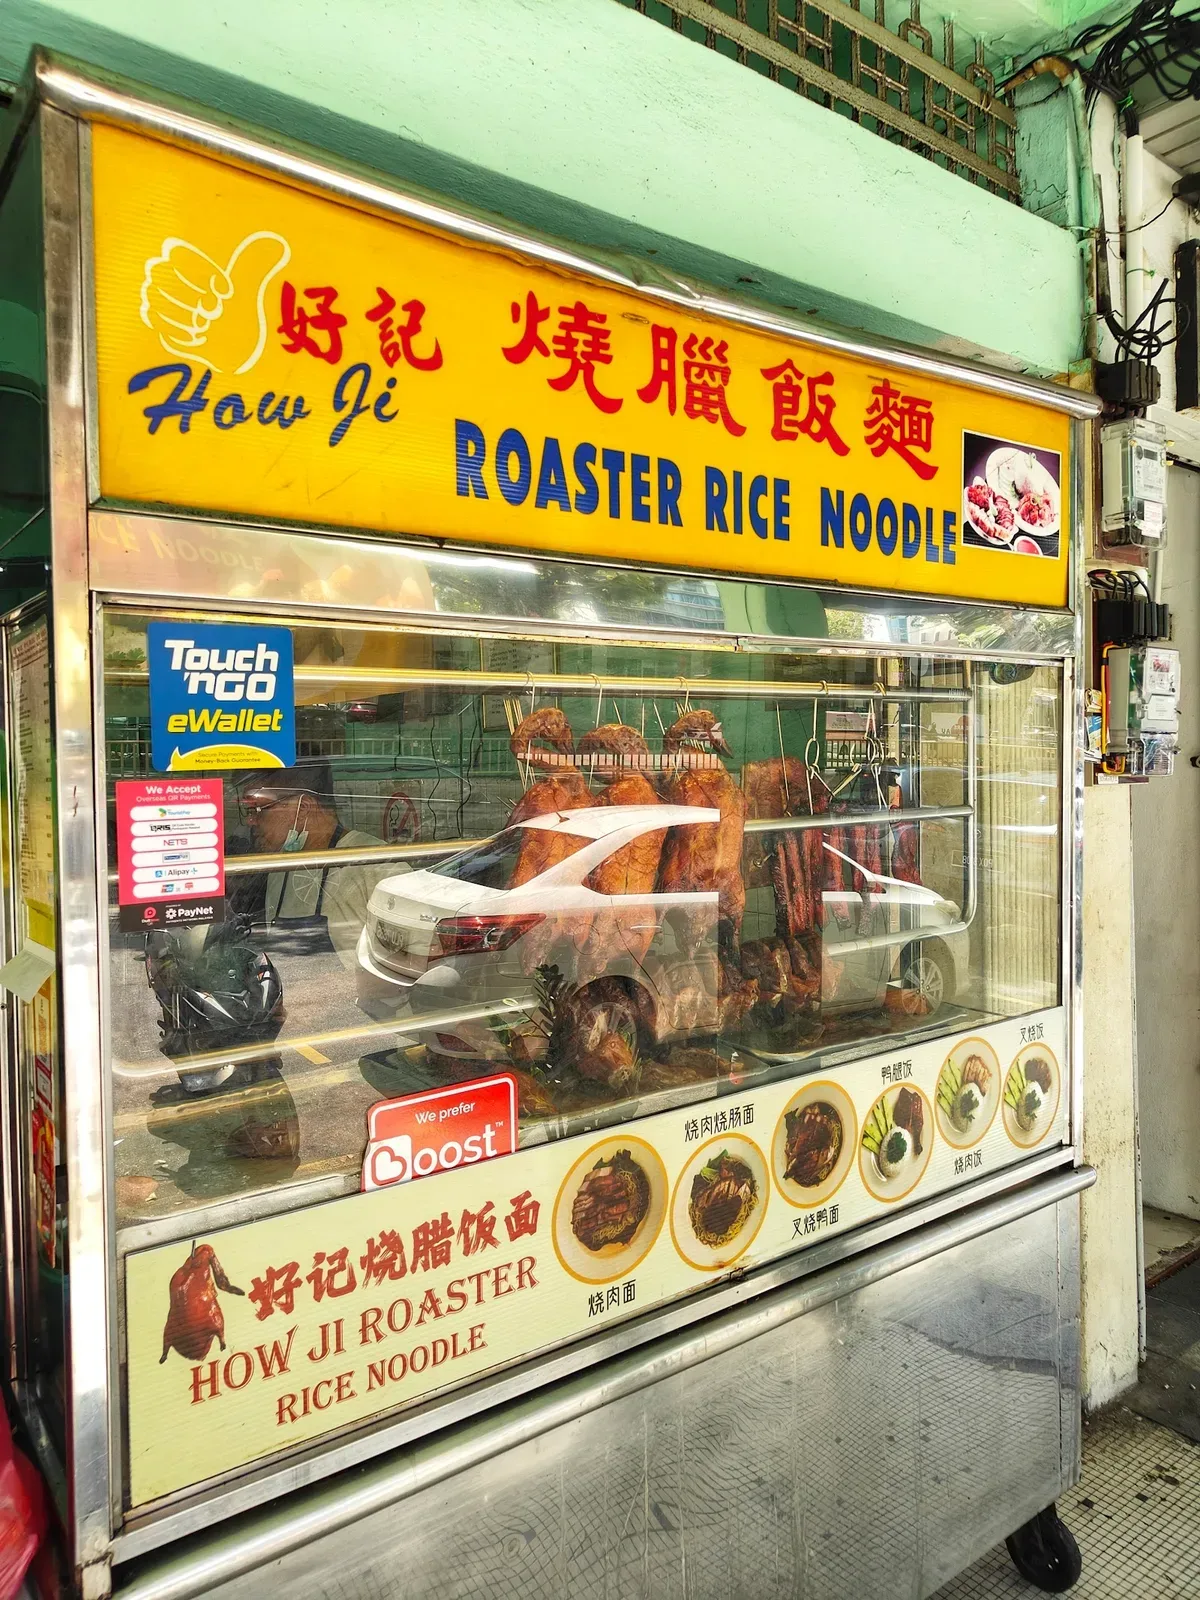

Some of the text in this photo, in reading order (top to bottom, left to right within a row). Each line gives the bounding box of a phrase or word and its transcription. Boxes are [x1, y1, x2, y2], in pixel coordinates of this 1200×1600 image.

[276, 280, 939, 481] 好記 燒臘飯麵
[127, 362, 400, 448] How Ji
[454, 417, 957, 566] ROASTER RICE NOODLE
[164, 639, 279, 672] Touch
[167, 708, 284, 733] eWallet
[136, 795, 166, 803] Overseas
[180, 793, 211, 802] Payments
[146, 784, 201, 795] We Accept
[163, 838, 188, 846] NETS
[178, 906, 214, 917] PayNet
[1019, 1022, 1045, 1045] 叉烧饭
[881, 1059, 914, 1085] 鸭腿饭
[415, 1101, 476, 1125] We prefer
[684, 1103, 755, 1143] 烧肉烧肠面
[954, 1149, 983, 1176] 烧肉饭
[791, 1204, 840, 1240] 叉烧鸭面
[248, 1189, 542, 1322] 好记烧腊饭面
[587, 1278, 637, 1318] 烧肉面
[190, 1255, 541, 1406] HOW JI ROASTER
[276, 1322, 489, 1427] RICE NOODLE
